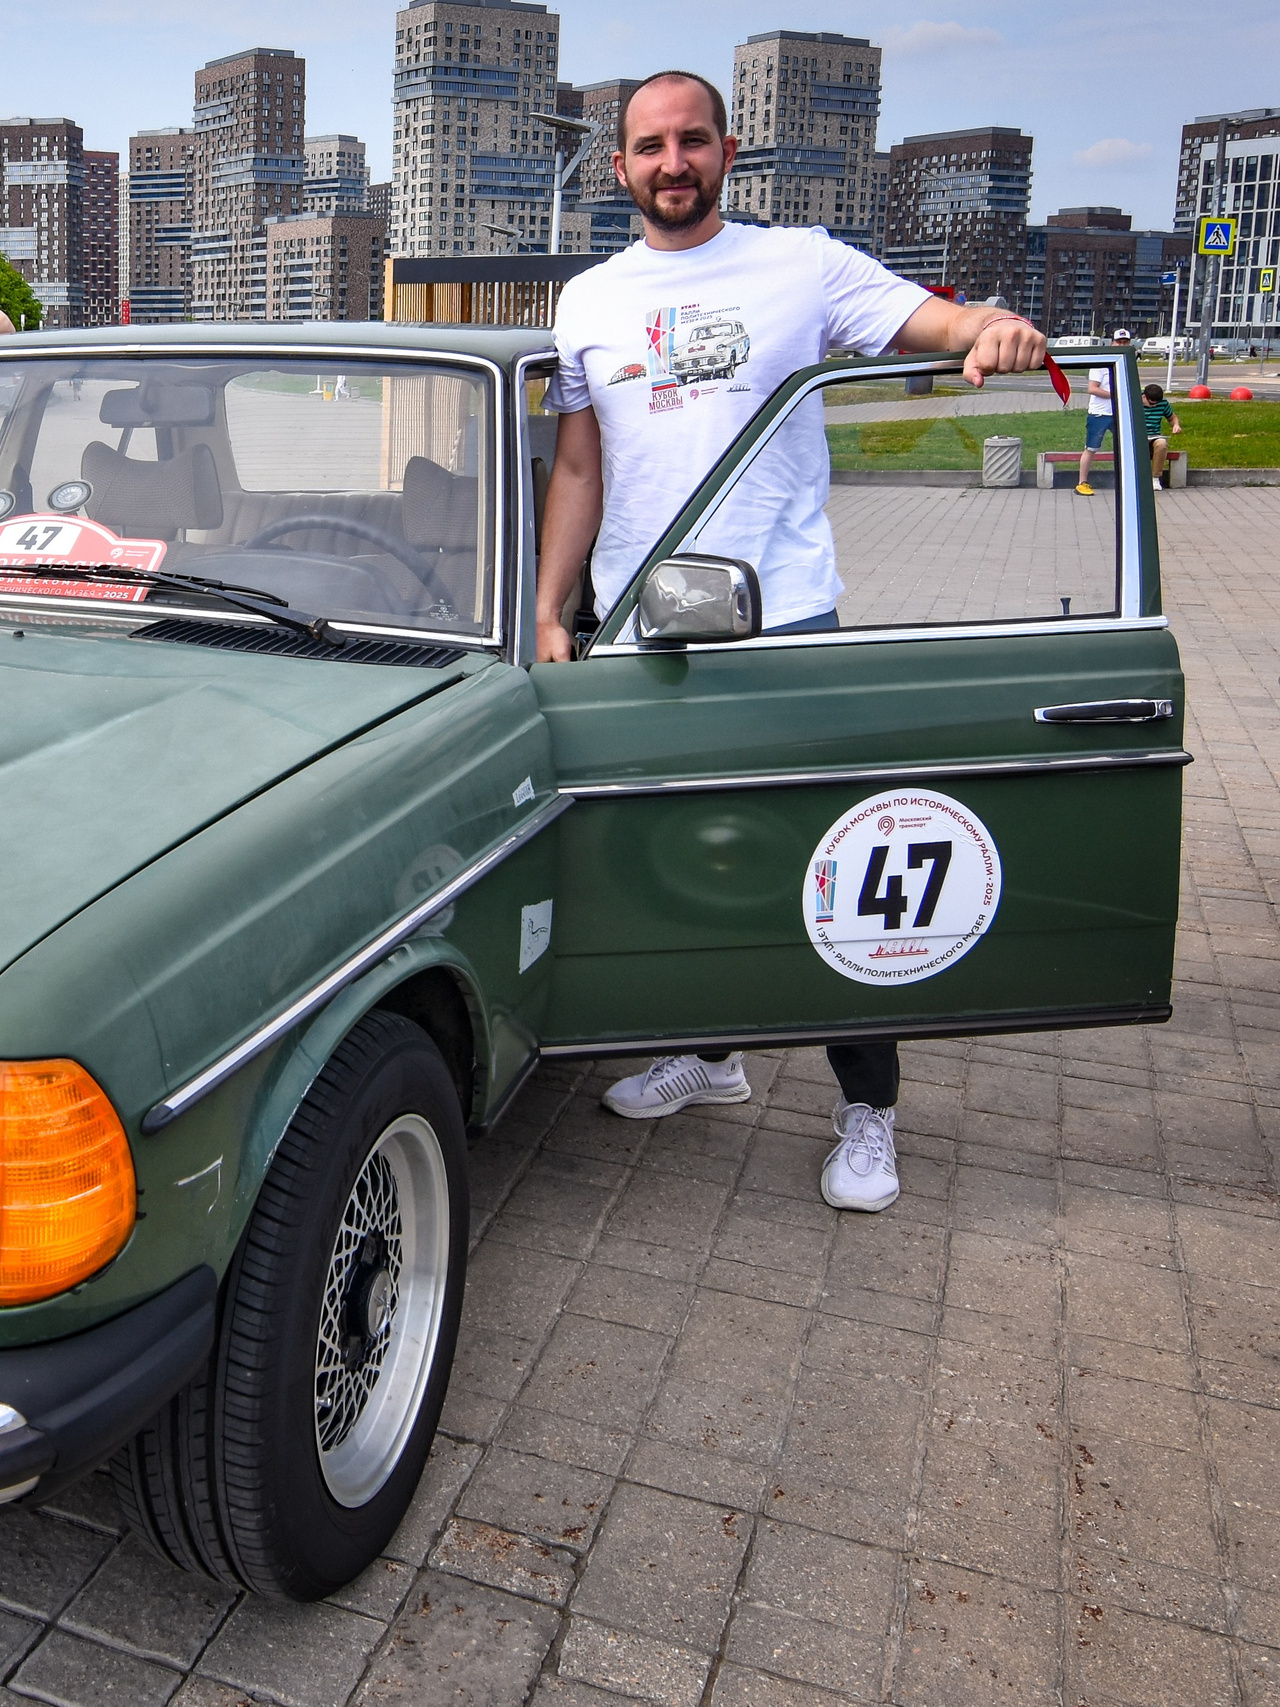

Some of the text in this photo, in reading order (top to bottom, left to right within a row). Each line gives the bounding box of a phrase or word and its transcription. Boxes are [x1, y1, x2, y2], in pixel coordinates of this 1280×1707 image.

[649, 396, 683, 411] МОСКВЫ
[652, 388, 677, 401] КУБОК
[16, 526, 63, 550] 47
[64, 588, 96, 597] МУЗЕЯ
[103, 591, 129, 599] 2025
[899, 815, 932, 823] Московский
[825, 797, 994, 906] КУБОК МОСКВЫ ПО ИСТОРИЧЕСКОМУ РАЛЛИ 2025
[857, 841, 952, 930] 47
[818, 931, 834, 952] ЭТАП
[835, 953, 864, 974] РАЛЛИ
[864, 941, 964, 978] ПОЛИТЕХНИЧЕСКОГО
[963, 914, 986, 942] МУЗЕЯ
